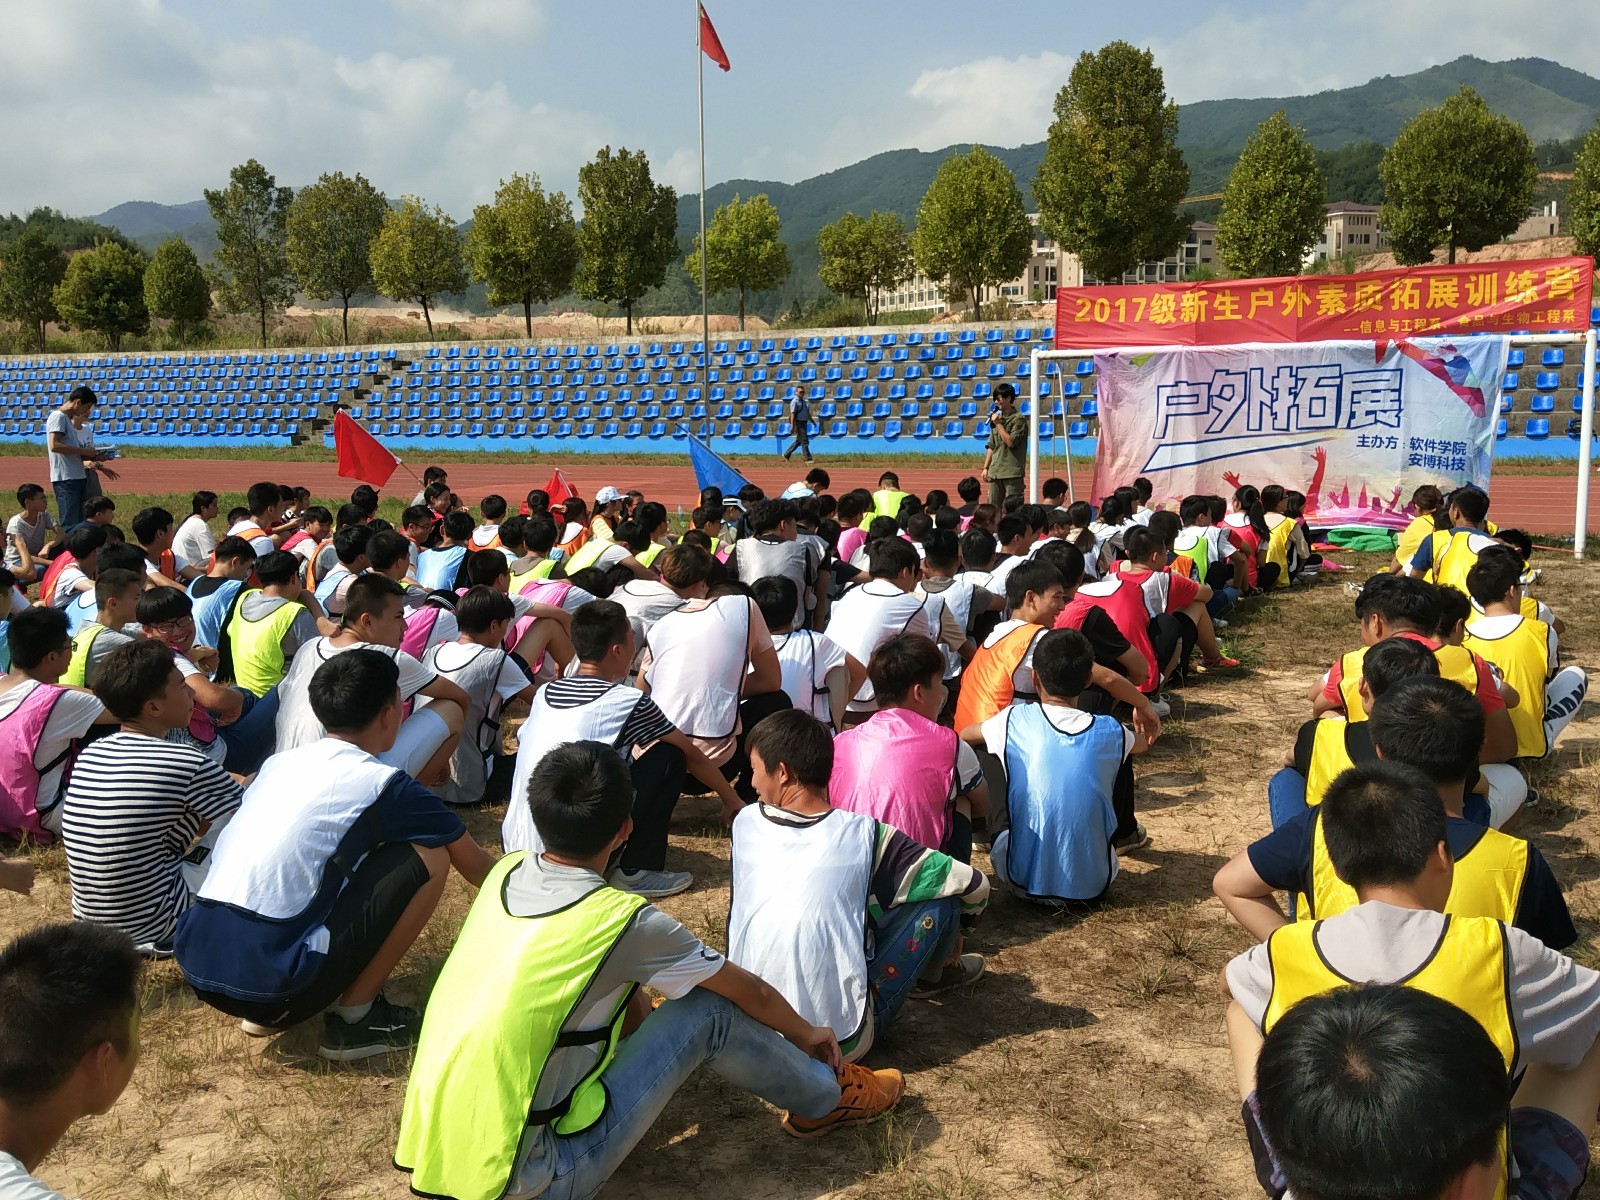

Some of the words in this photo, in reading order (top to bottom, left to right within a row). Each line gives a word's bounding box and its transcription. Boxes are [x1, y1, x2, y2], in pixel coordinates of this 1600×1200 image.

[1074, 266, 1580, 325] 2017级新生户外素质拓展训练营
[1152, 363, 1404, 440] 户外拓展
[1408, 452, 1466, 472] 安博科技
